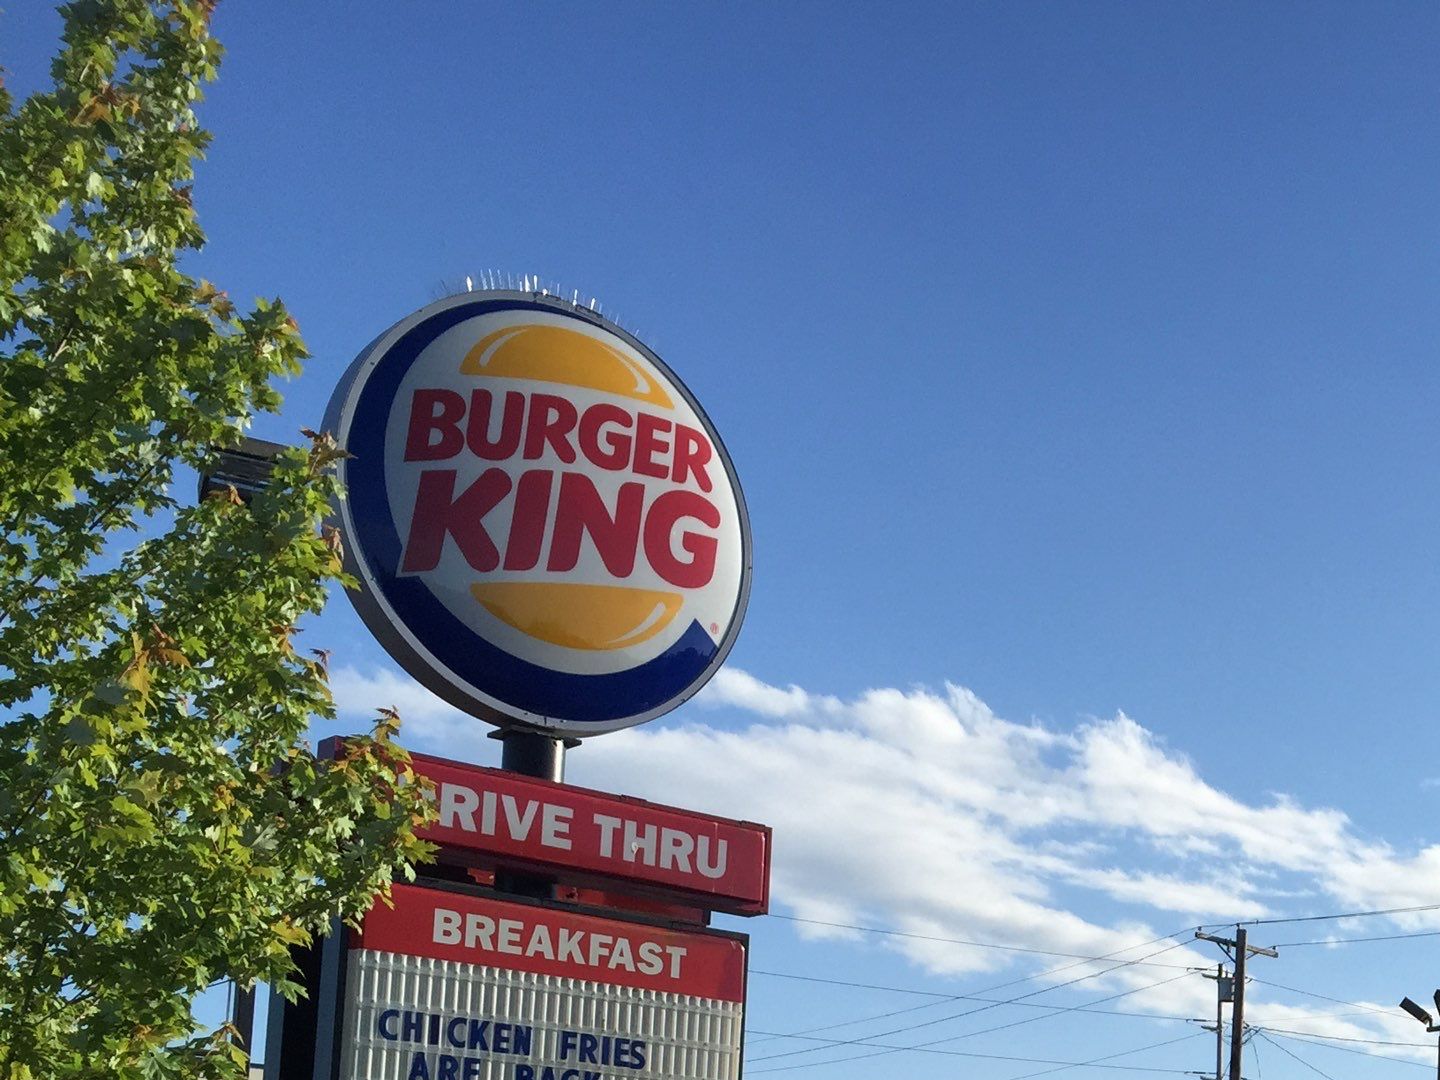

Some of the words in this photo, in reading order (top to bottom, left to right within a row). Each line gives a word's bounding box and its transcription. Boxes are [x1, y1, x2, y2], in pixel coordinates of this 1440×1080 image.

[403, 388, 713, 493] BURGER
[401, 467, 722, 590] KING
[426, 782, 575, 850] RIVE
[593, 813, 728, 880] THRU
[432, 907, 687, 979] BREAKFAST
[378, 1008, 533, 1056] CHICKEN
[560, 1030, 647, 1070] FRIES
